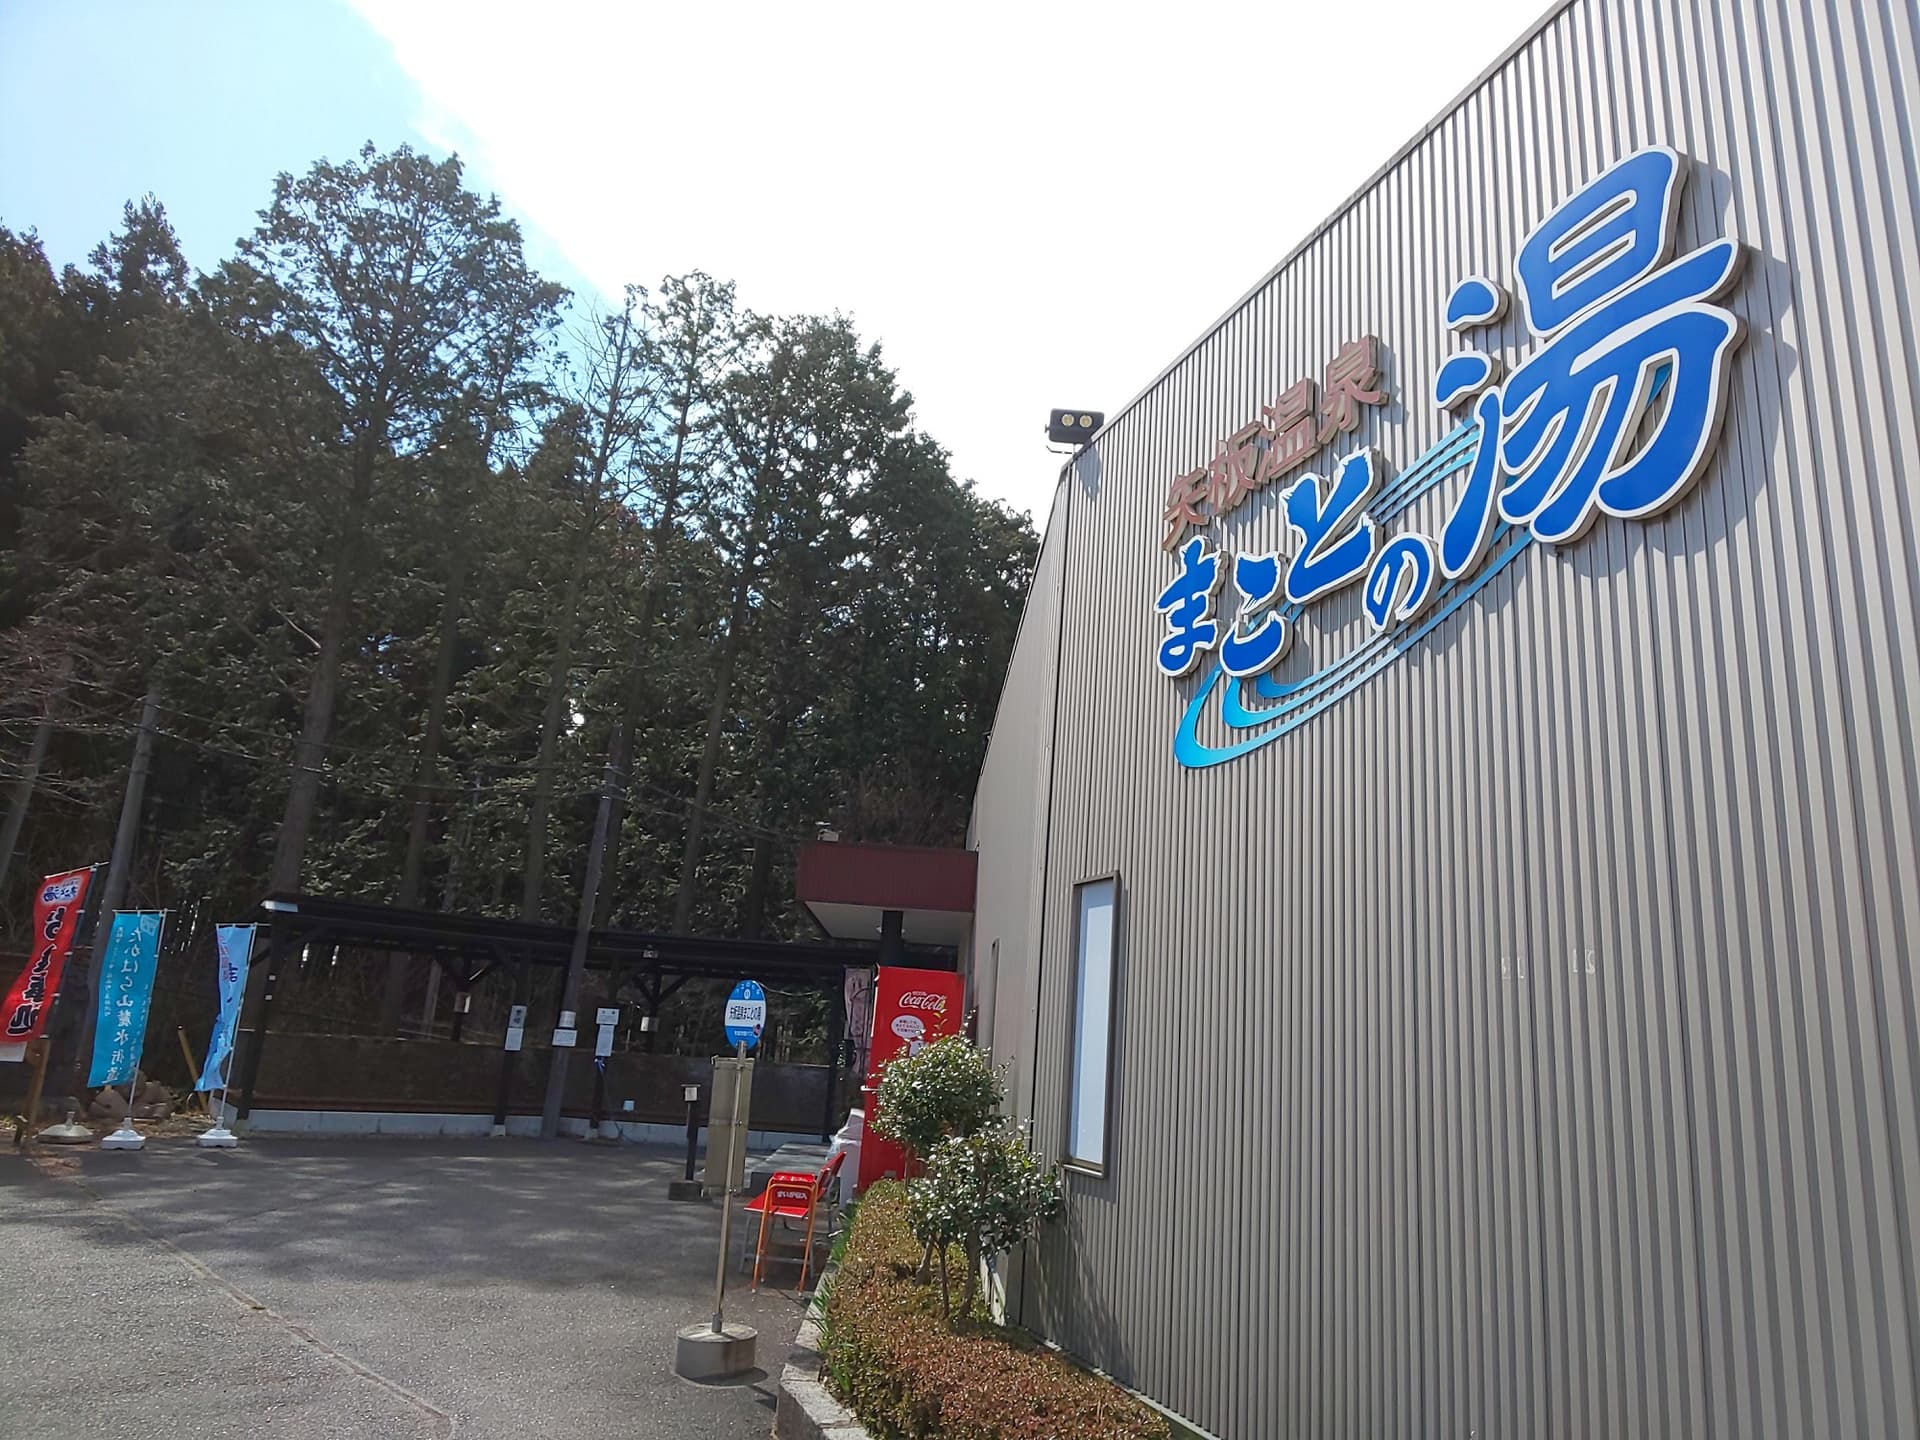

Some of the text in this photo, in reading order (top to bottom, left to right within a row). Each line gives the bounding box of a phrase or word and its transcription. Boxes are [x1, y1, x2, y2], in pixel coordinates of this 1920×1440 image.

[1154, 143, 1748, 680] まことの湯
[1162, 335, 1388, 552] 矢板温泉
[899, 991, 946, 1011] Coca-Cola
